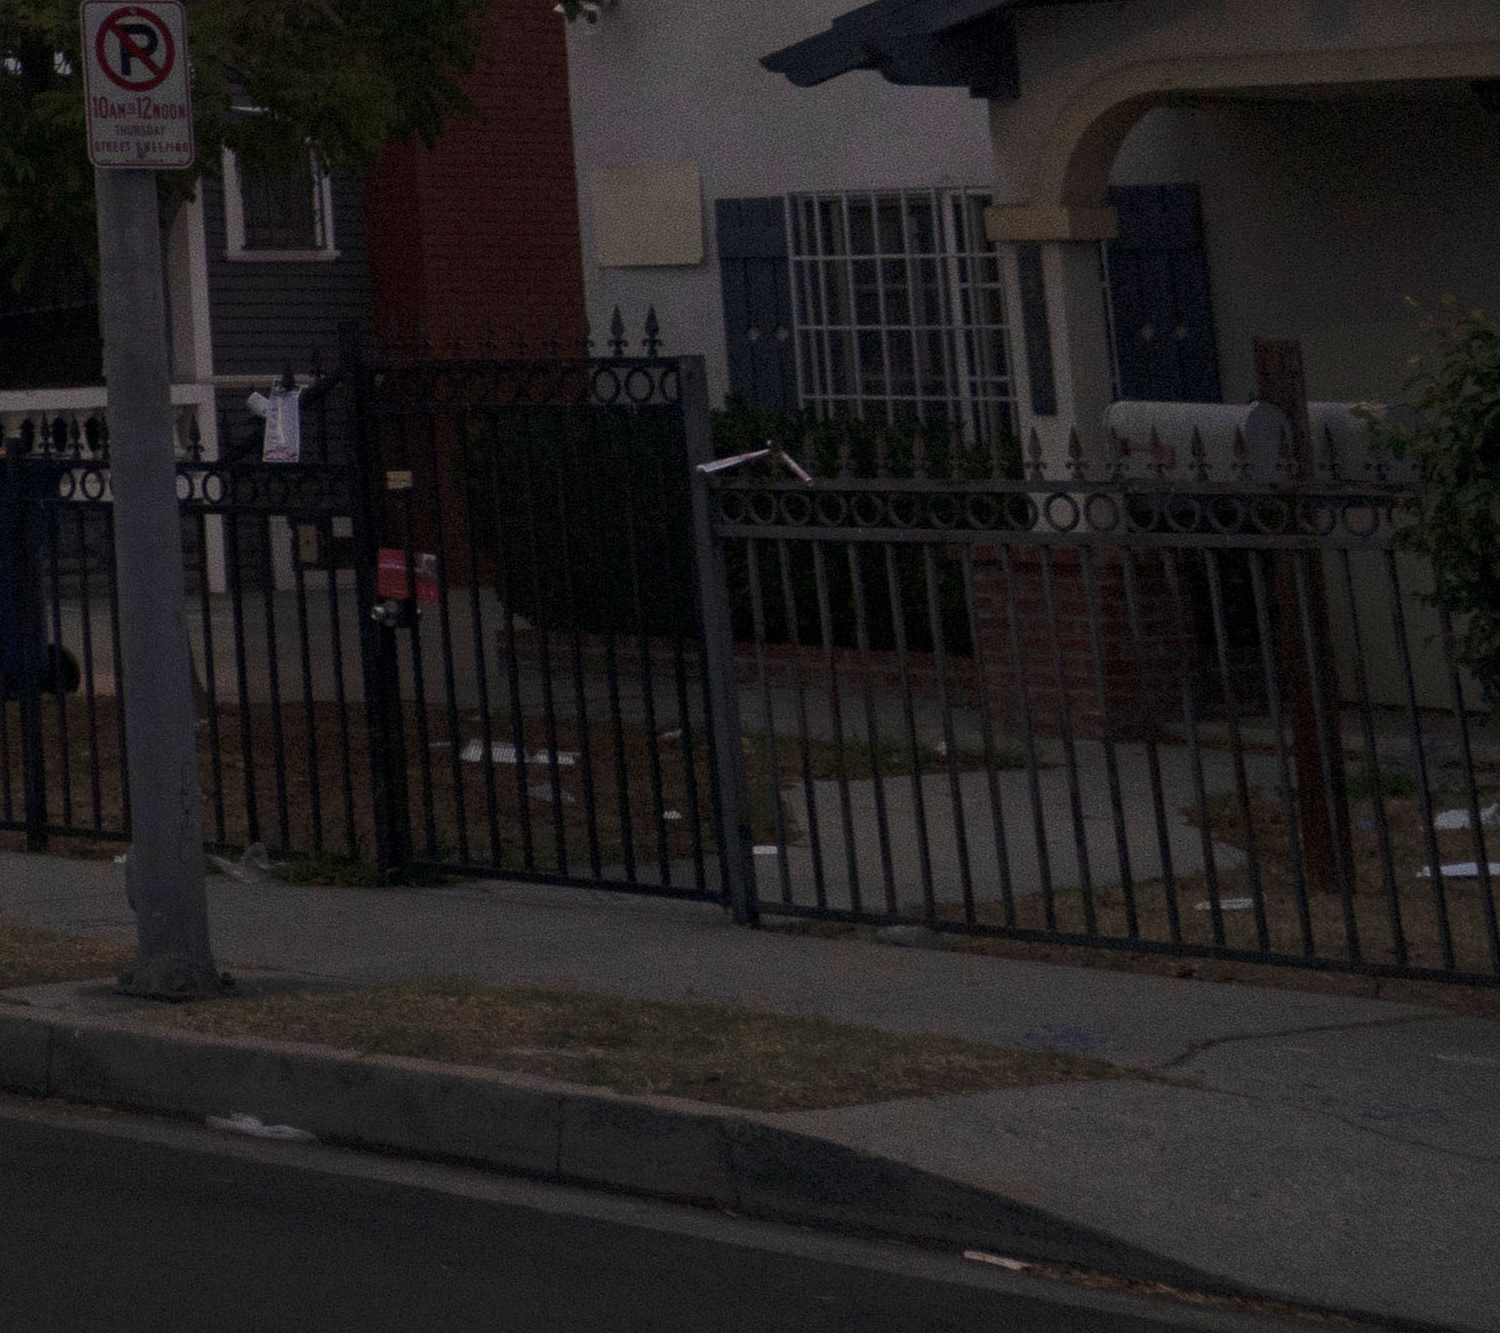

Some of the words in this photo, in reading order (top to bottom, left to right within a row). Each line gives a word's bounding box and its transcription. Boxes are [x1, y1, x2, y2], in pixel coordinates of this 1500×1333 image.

[92, 96, 126, 119] 10AM
[136, 96, 187, 120] 12NOON
[115, 124, 166, 136] THURSDAY
[93, 140, 131, 152] STREET
